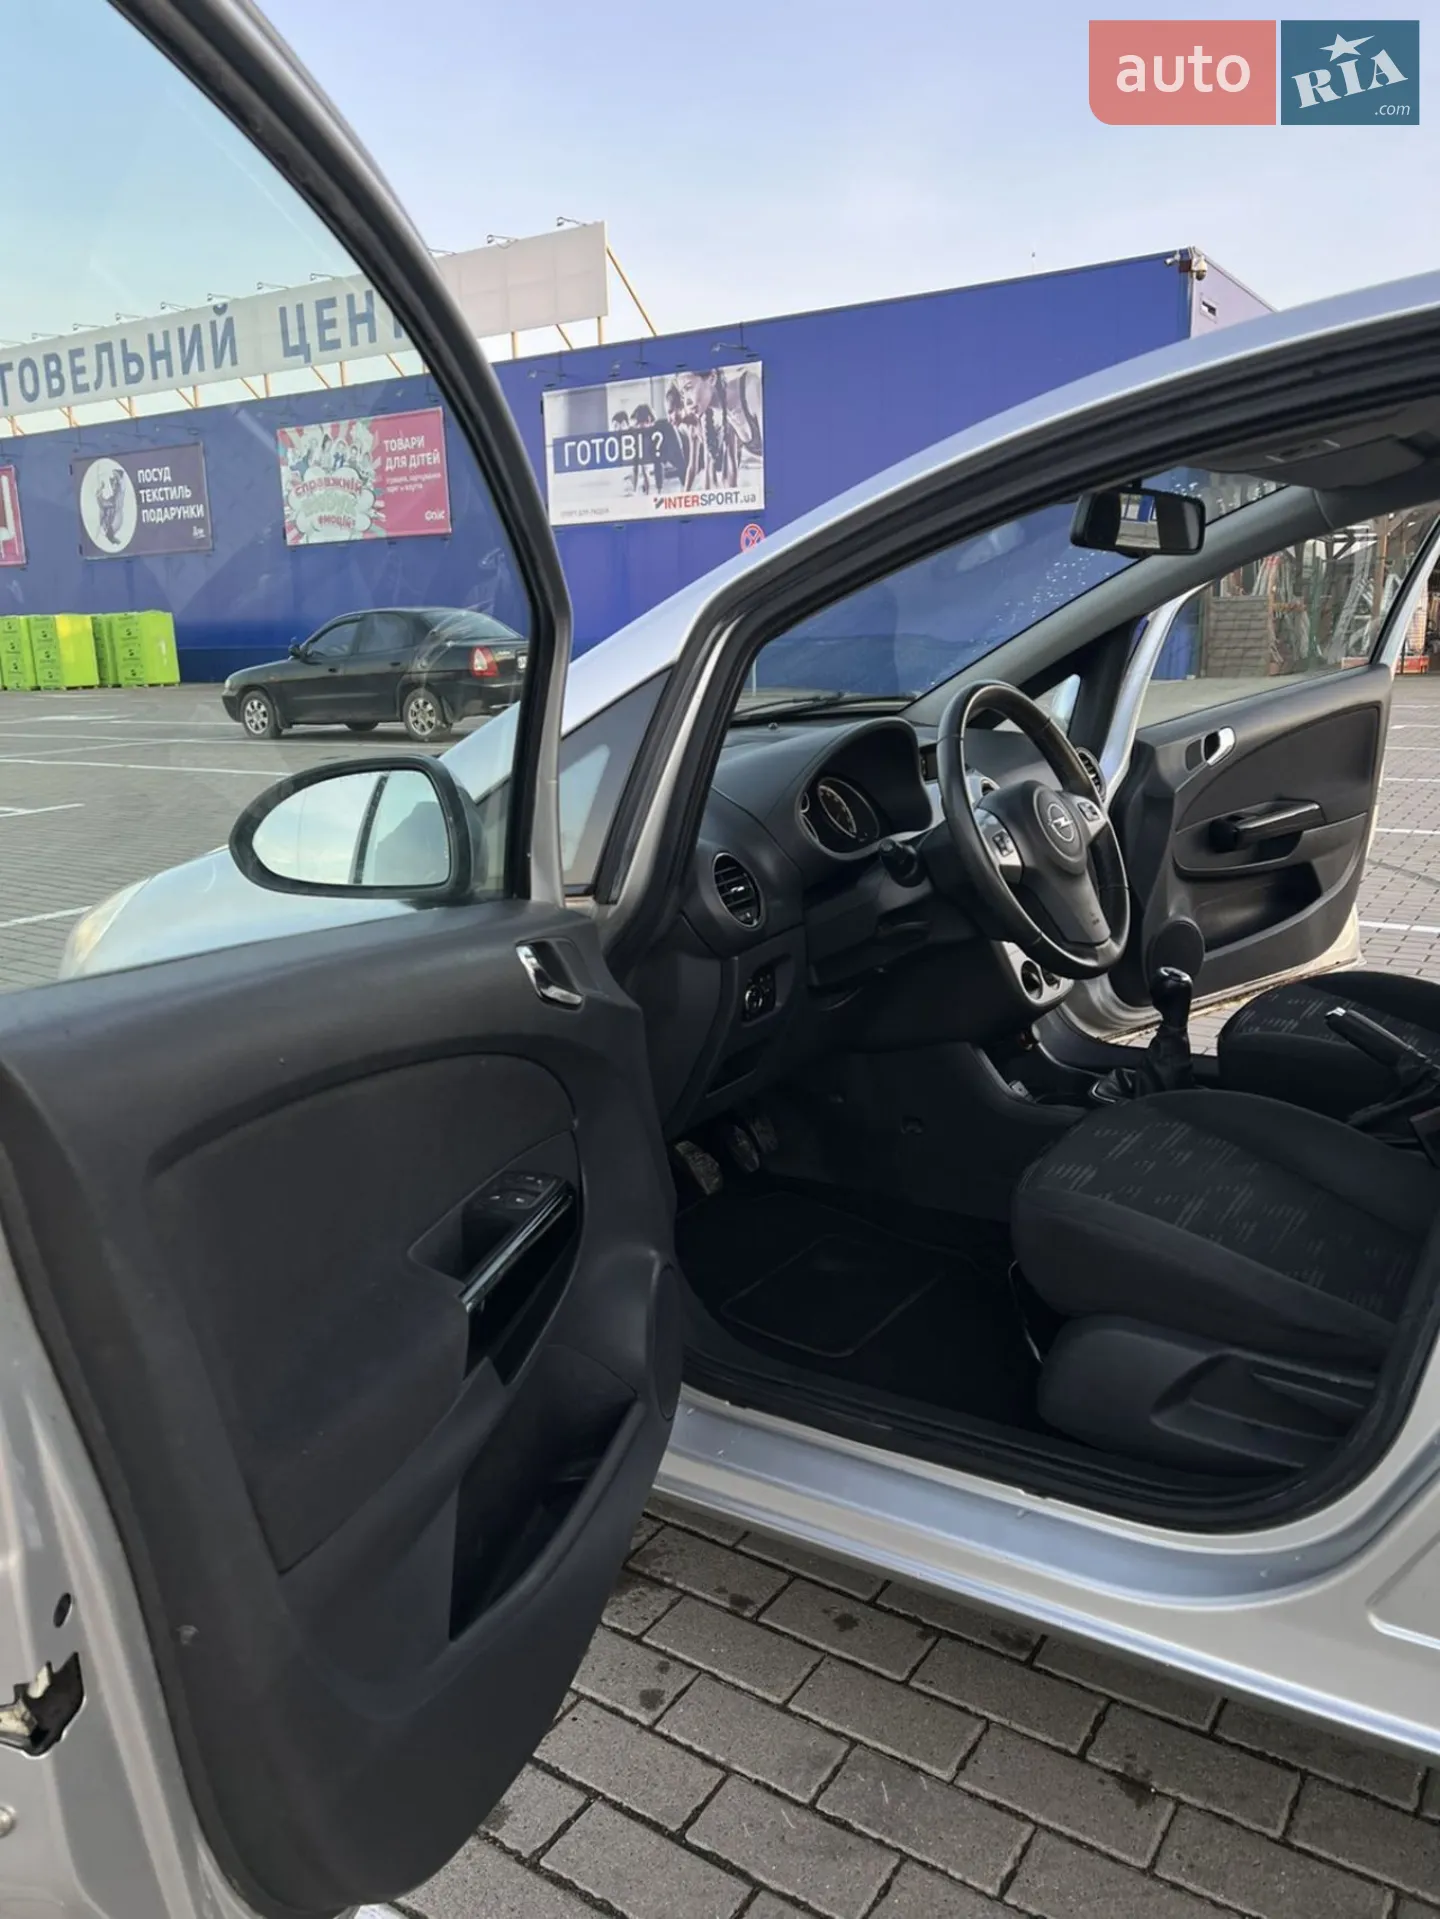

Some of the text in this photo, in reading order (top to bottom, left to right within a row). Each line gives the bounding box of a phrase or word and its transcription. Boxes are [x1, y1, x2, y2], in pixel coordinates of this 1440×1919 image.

[384, 435, 425, 453] ТОВАРИ
[564, 434, 644, 467] ГОТОВІ
[384, 448, 441, 472] ДЛЯ ДІТЕЙ
[137, 466, 172, 484] ПОСУД
[139, 484, 192, 503] ТЕКСТИЛЬ
[664, 491, 756, 509] INTERSPORT.ua
[142, 504, 205, 523] ПОДАРУНКИ
